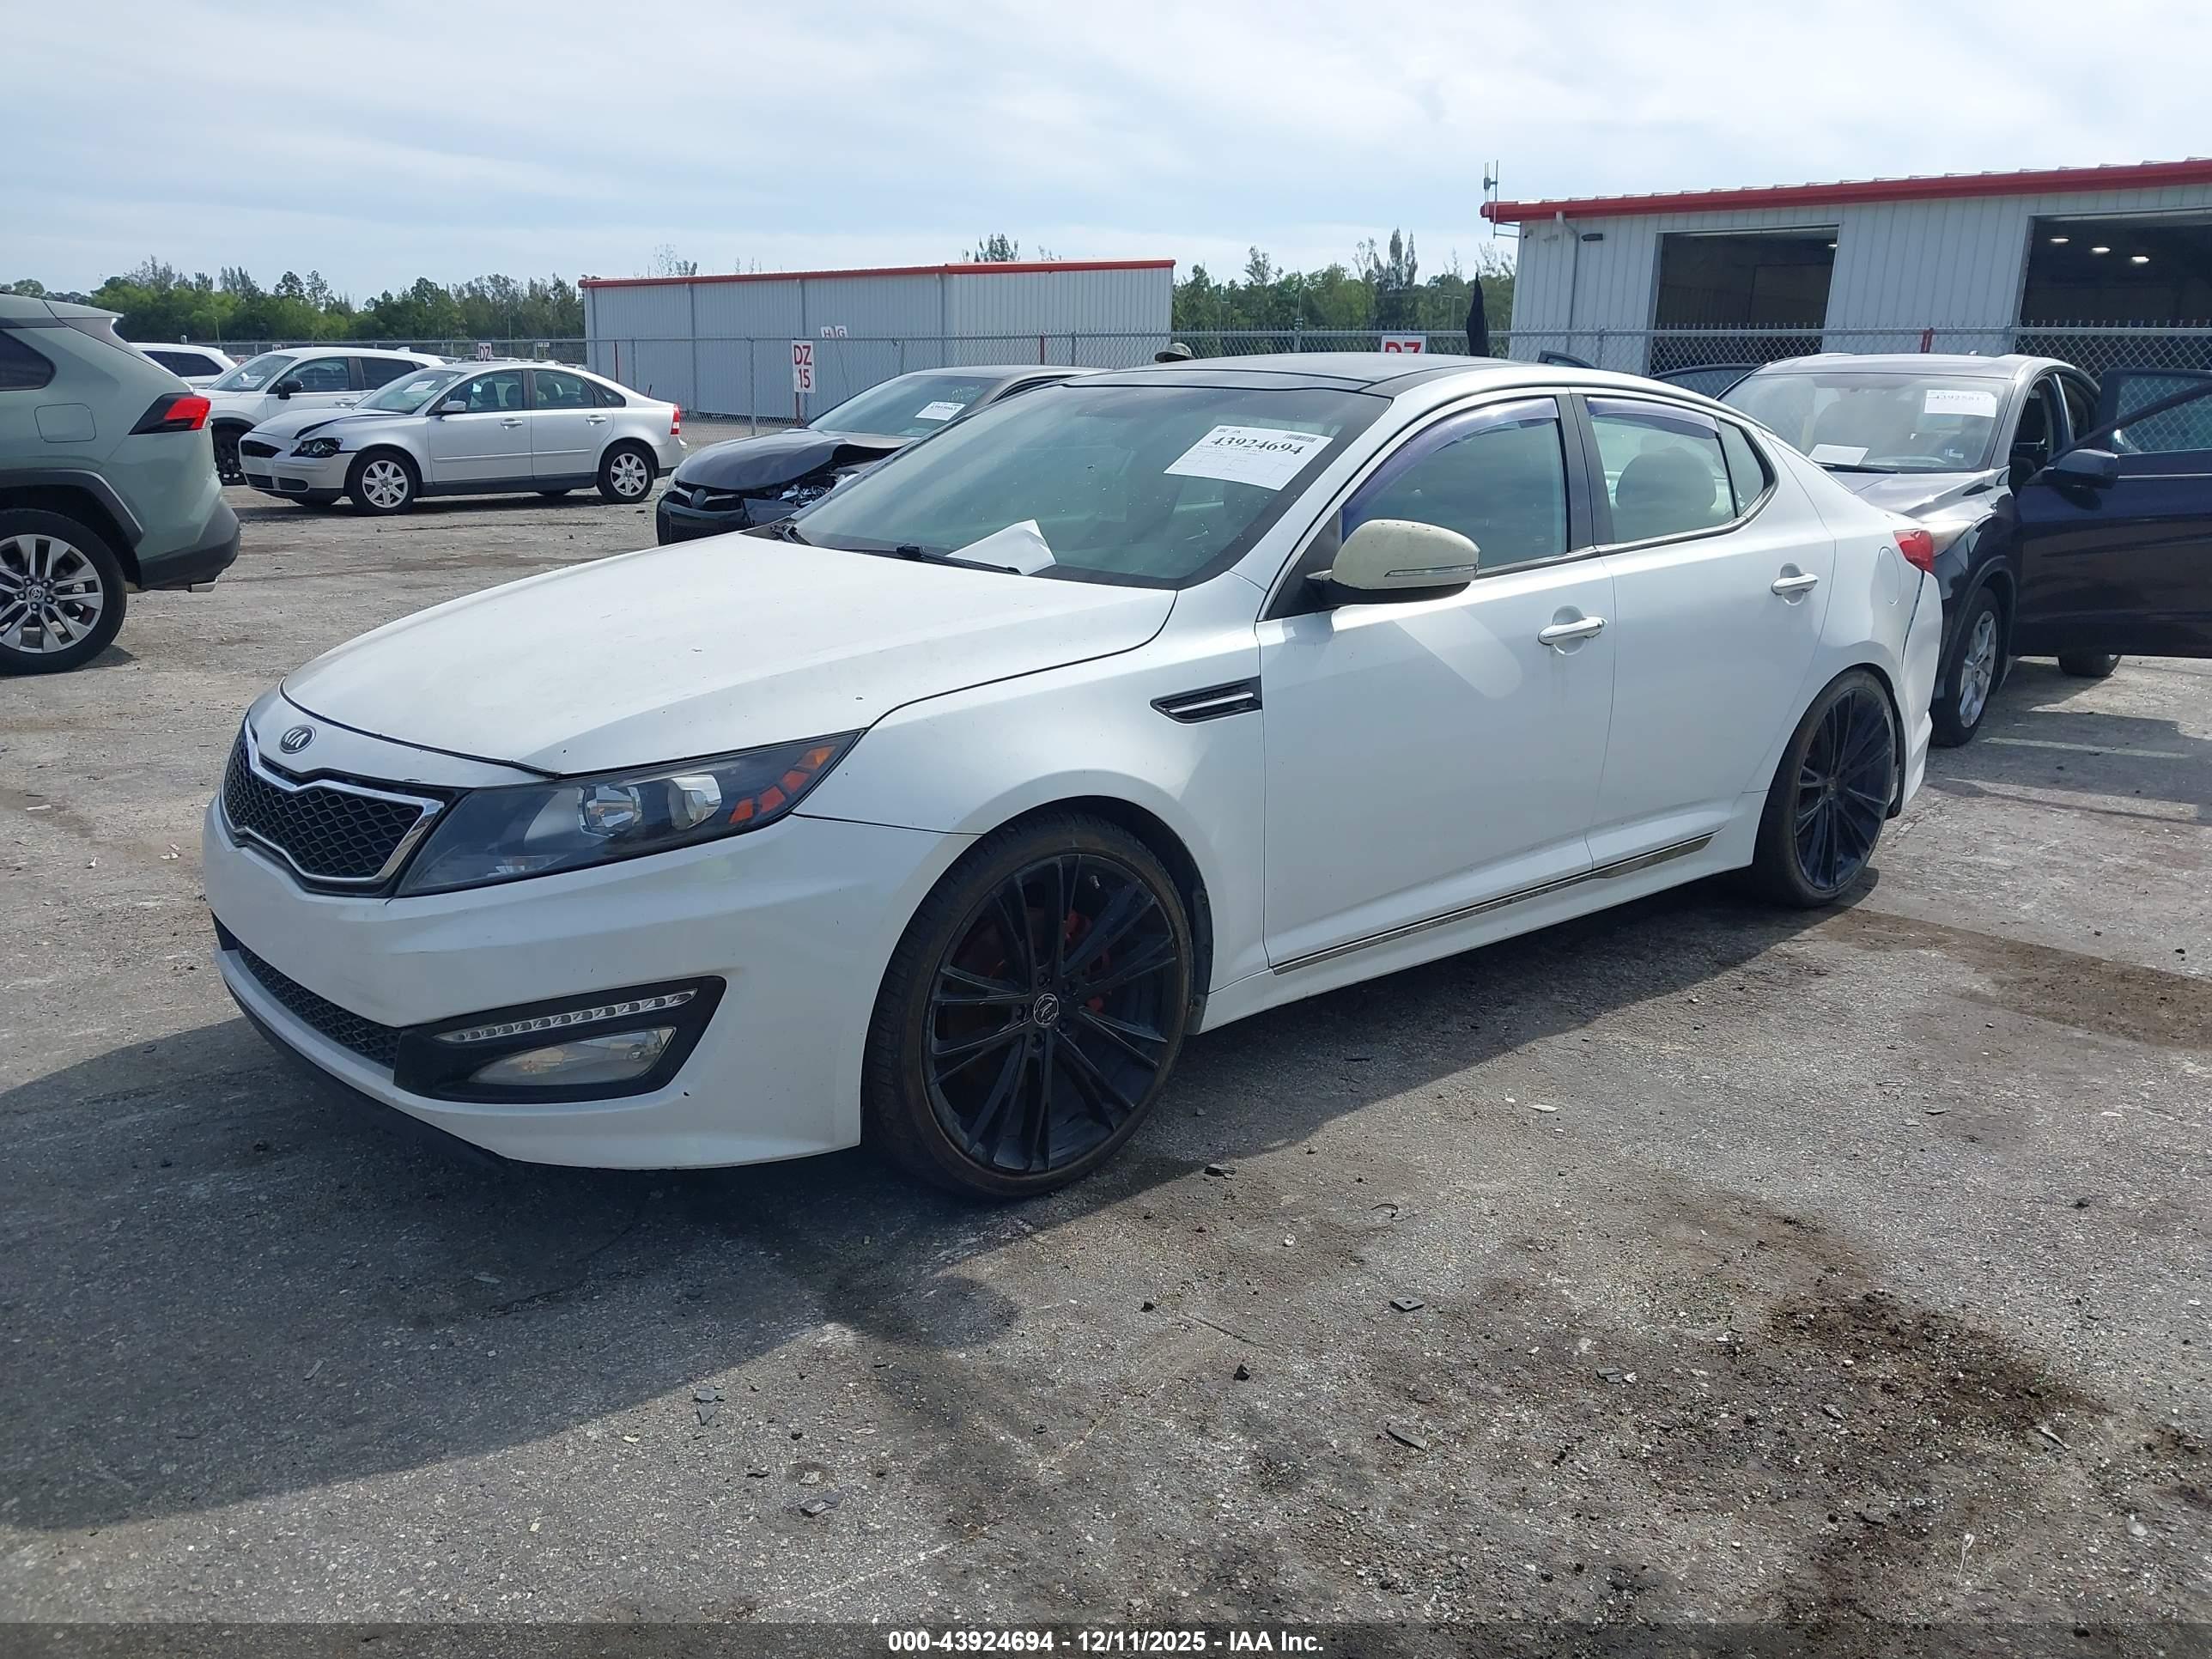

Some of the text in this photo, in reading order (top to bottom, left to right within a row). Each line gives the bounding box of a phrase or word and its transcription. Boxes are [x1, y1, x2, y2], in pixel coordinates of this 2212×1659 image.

[480, 346, 490, 362] DZ
[793, 344, 812, 366] DZ
[799, 368, 811, 388] 15
[1211, 436, 1305, 455] 43924694
